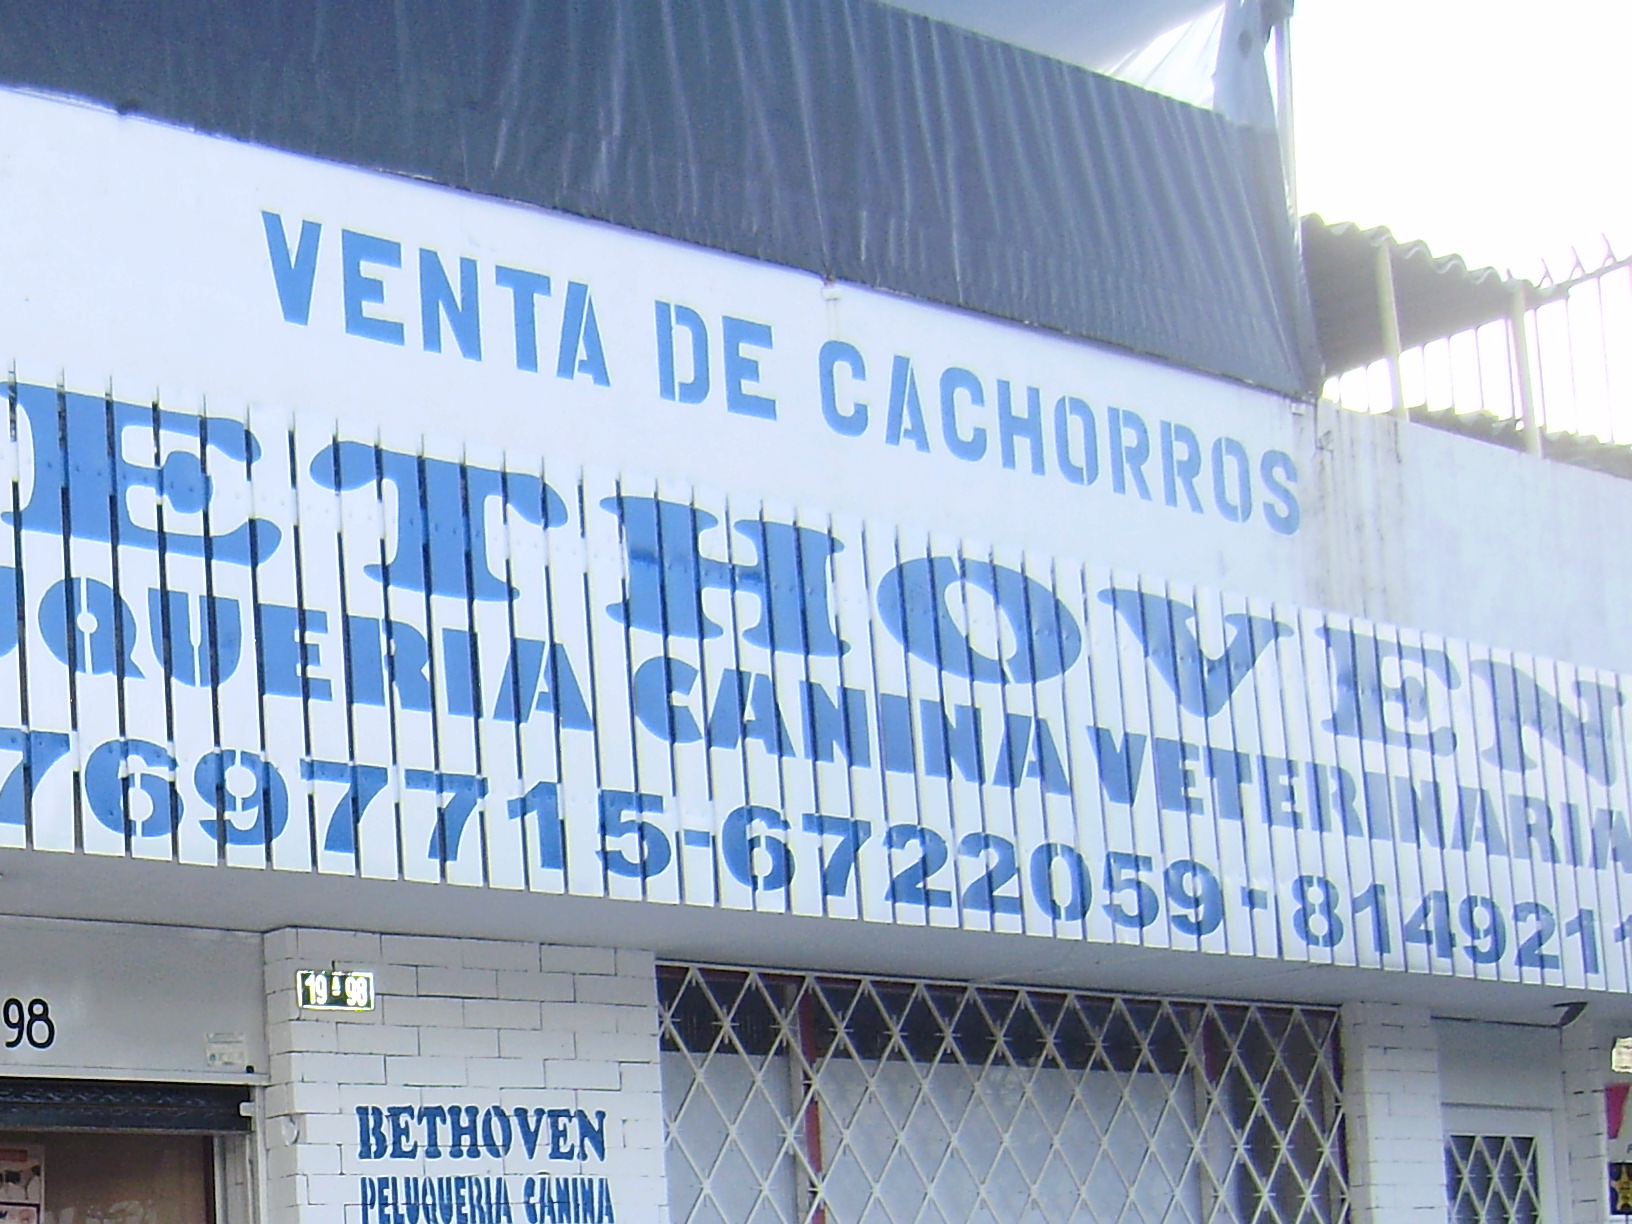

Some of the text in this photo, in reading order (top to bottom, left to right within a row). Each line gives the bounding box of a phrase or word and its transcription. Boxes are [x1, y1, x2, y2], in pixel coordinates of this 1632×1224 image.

[261, 210, 1302, 536] VENTA DE CACHORROS
[633, 656, 1072, 796] CANINA
[1085, 724, 1632, 874] VETERINARIA
[2, 997, 56, 1049] 98
[355, 1104, 607, 1161] BETHOVEN
[523, 1176, 615, 1224] CANINA
